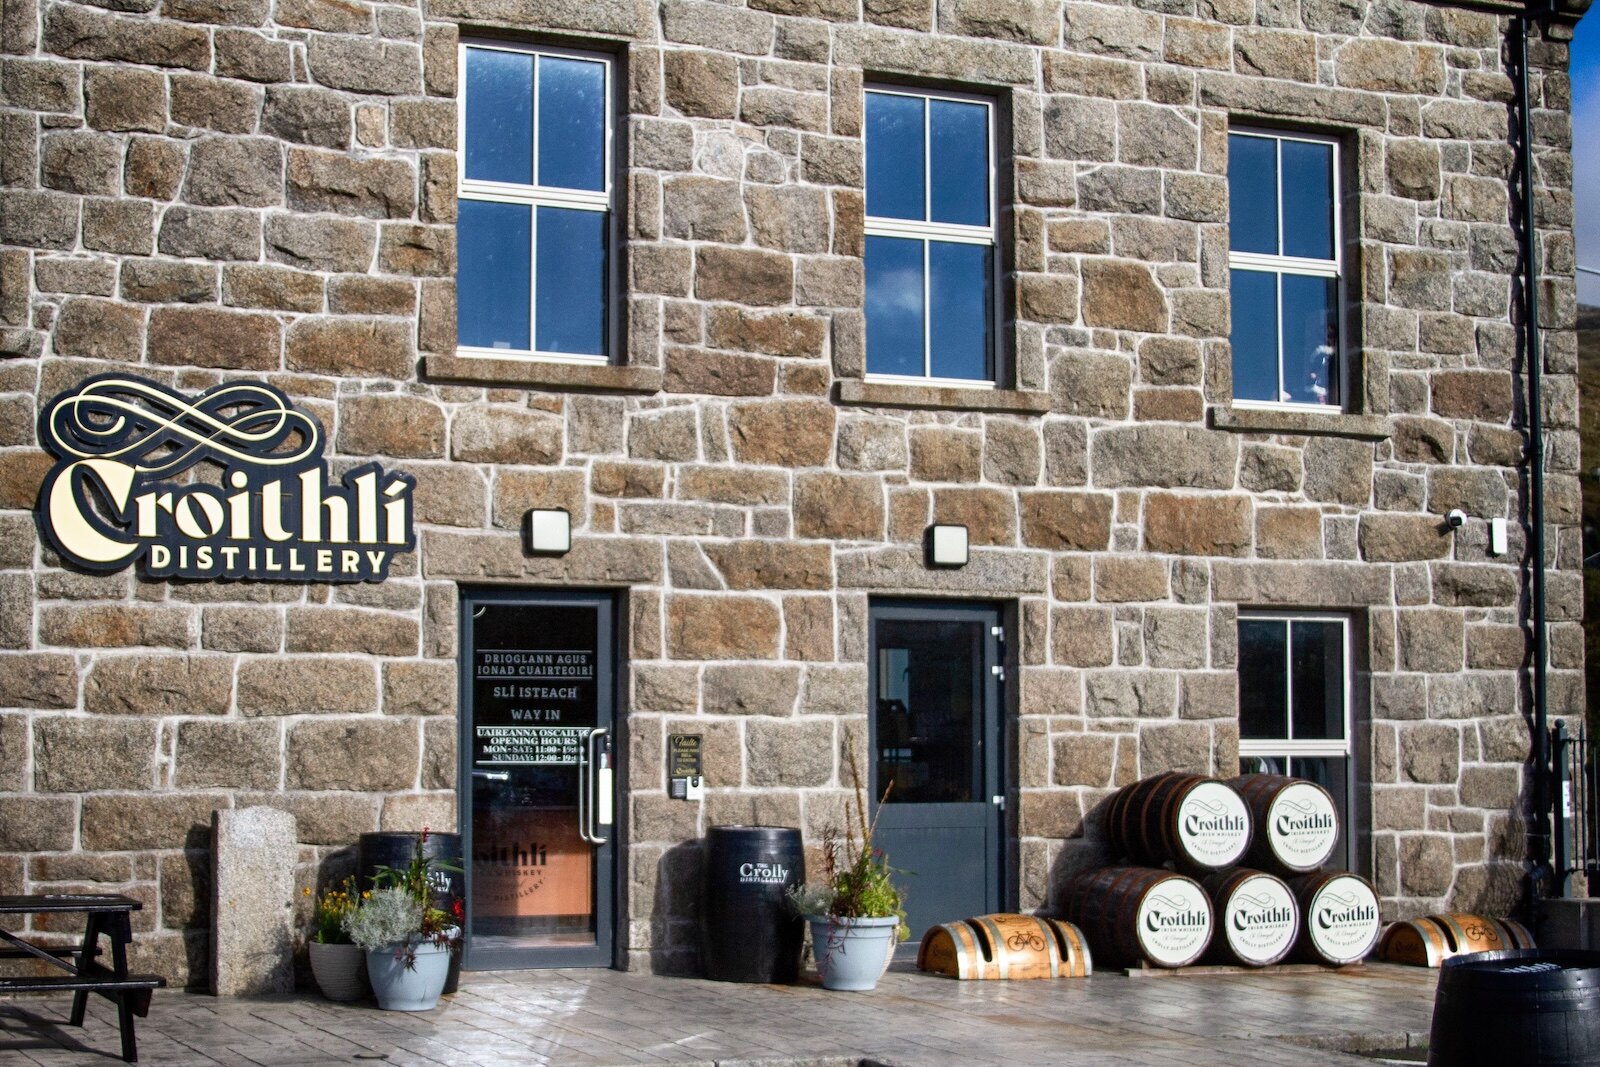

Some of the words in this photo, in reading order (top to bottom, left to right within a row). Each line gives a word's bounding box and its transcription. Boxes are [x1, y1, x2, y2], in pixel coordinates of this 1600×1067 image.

[50, 458, 407, 562] Croithlí
[150, 543, 387, 574] DISTILLERY
[484, 654, 553, 664] DRIOGLANN
[556, 655, 587, 664] AGUS
[477, 665, 515, 675] IONAD
[518, 665, 593, 676] CUAIRTEOIRÍ
[493, 685, 515, 698] SLÍ
[518, 687, 577, 698] ISTEACH
[511, 709, 541, 720] WAY
[545, 709, 561, 720] IN
[477, 728, 537, 737] UAIREANNA
[490, 737, 539, 745] OPENING
[541, 737, 578, 745] HOURS
[535, 745, 557, 753] 11:00
[491, 753, 534, 761] SUNDAY:
[535, 753, 557, 761] 12:00
[1185, 815, 1244, 837] Croithlí
[1276, 813, 1332, 837] Croithlí
[740, 863, 789, 883] Crolly
[1147, 911, 1205, 932] Croithlí
[1234, 907, 1290, 931] Croithlí
[1318, 906, 1374, 929] Croithlí
